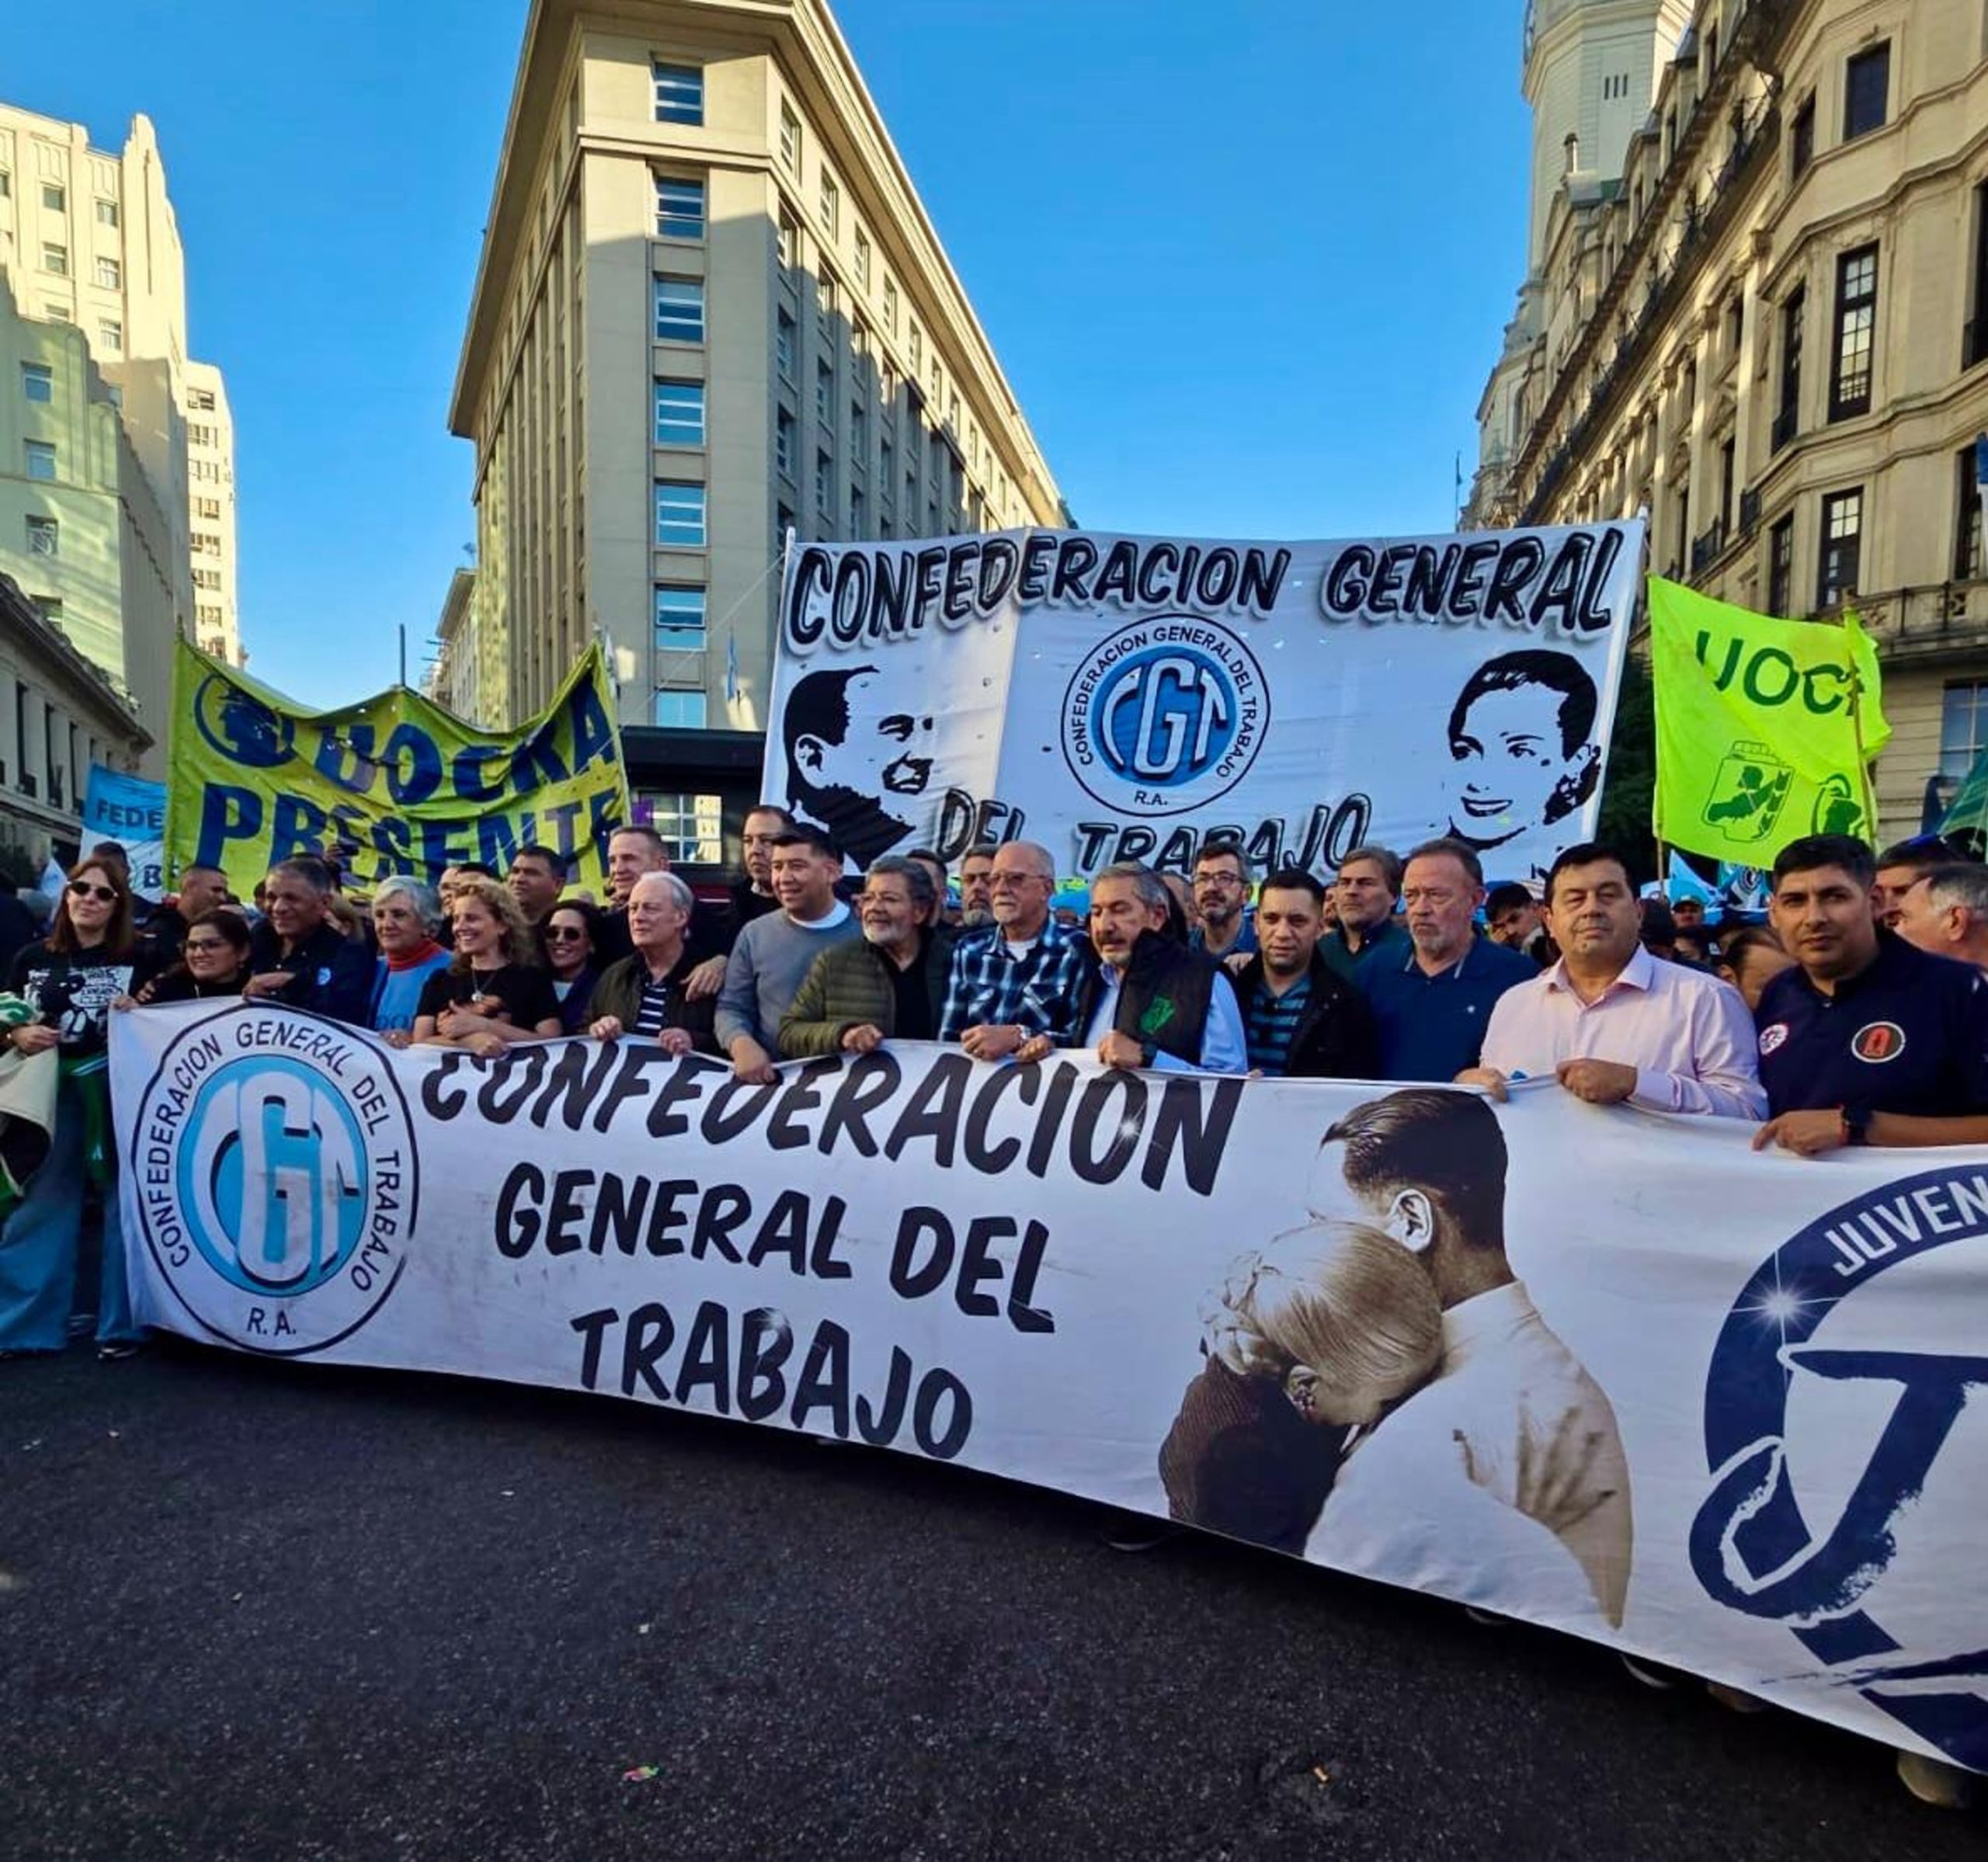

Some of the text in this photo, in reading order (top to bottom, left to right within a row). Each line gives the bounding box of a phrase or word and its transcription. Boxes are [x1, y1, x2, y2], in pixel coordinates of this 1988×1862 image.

[788, 527, 1625, 645] CONFEDERACION GENERAL
[1071, 626, 1257, 778] CONFEDERACION GENERAL DEL TRABAJO
[1134, 790, 1169, 814] R.A.
[147, 1020, 400, 1292] CONFEDERACION GENERAL DEL TRABAJO
[421, 1040, 1245, 1197] CONFEDERACION
[245, 1307, 297, 1336] R.A.
[495, 1162, 1055, 1334] GENERAL DEL
[569, 1300, 973, 1459] TRABAJO
